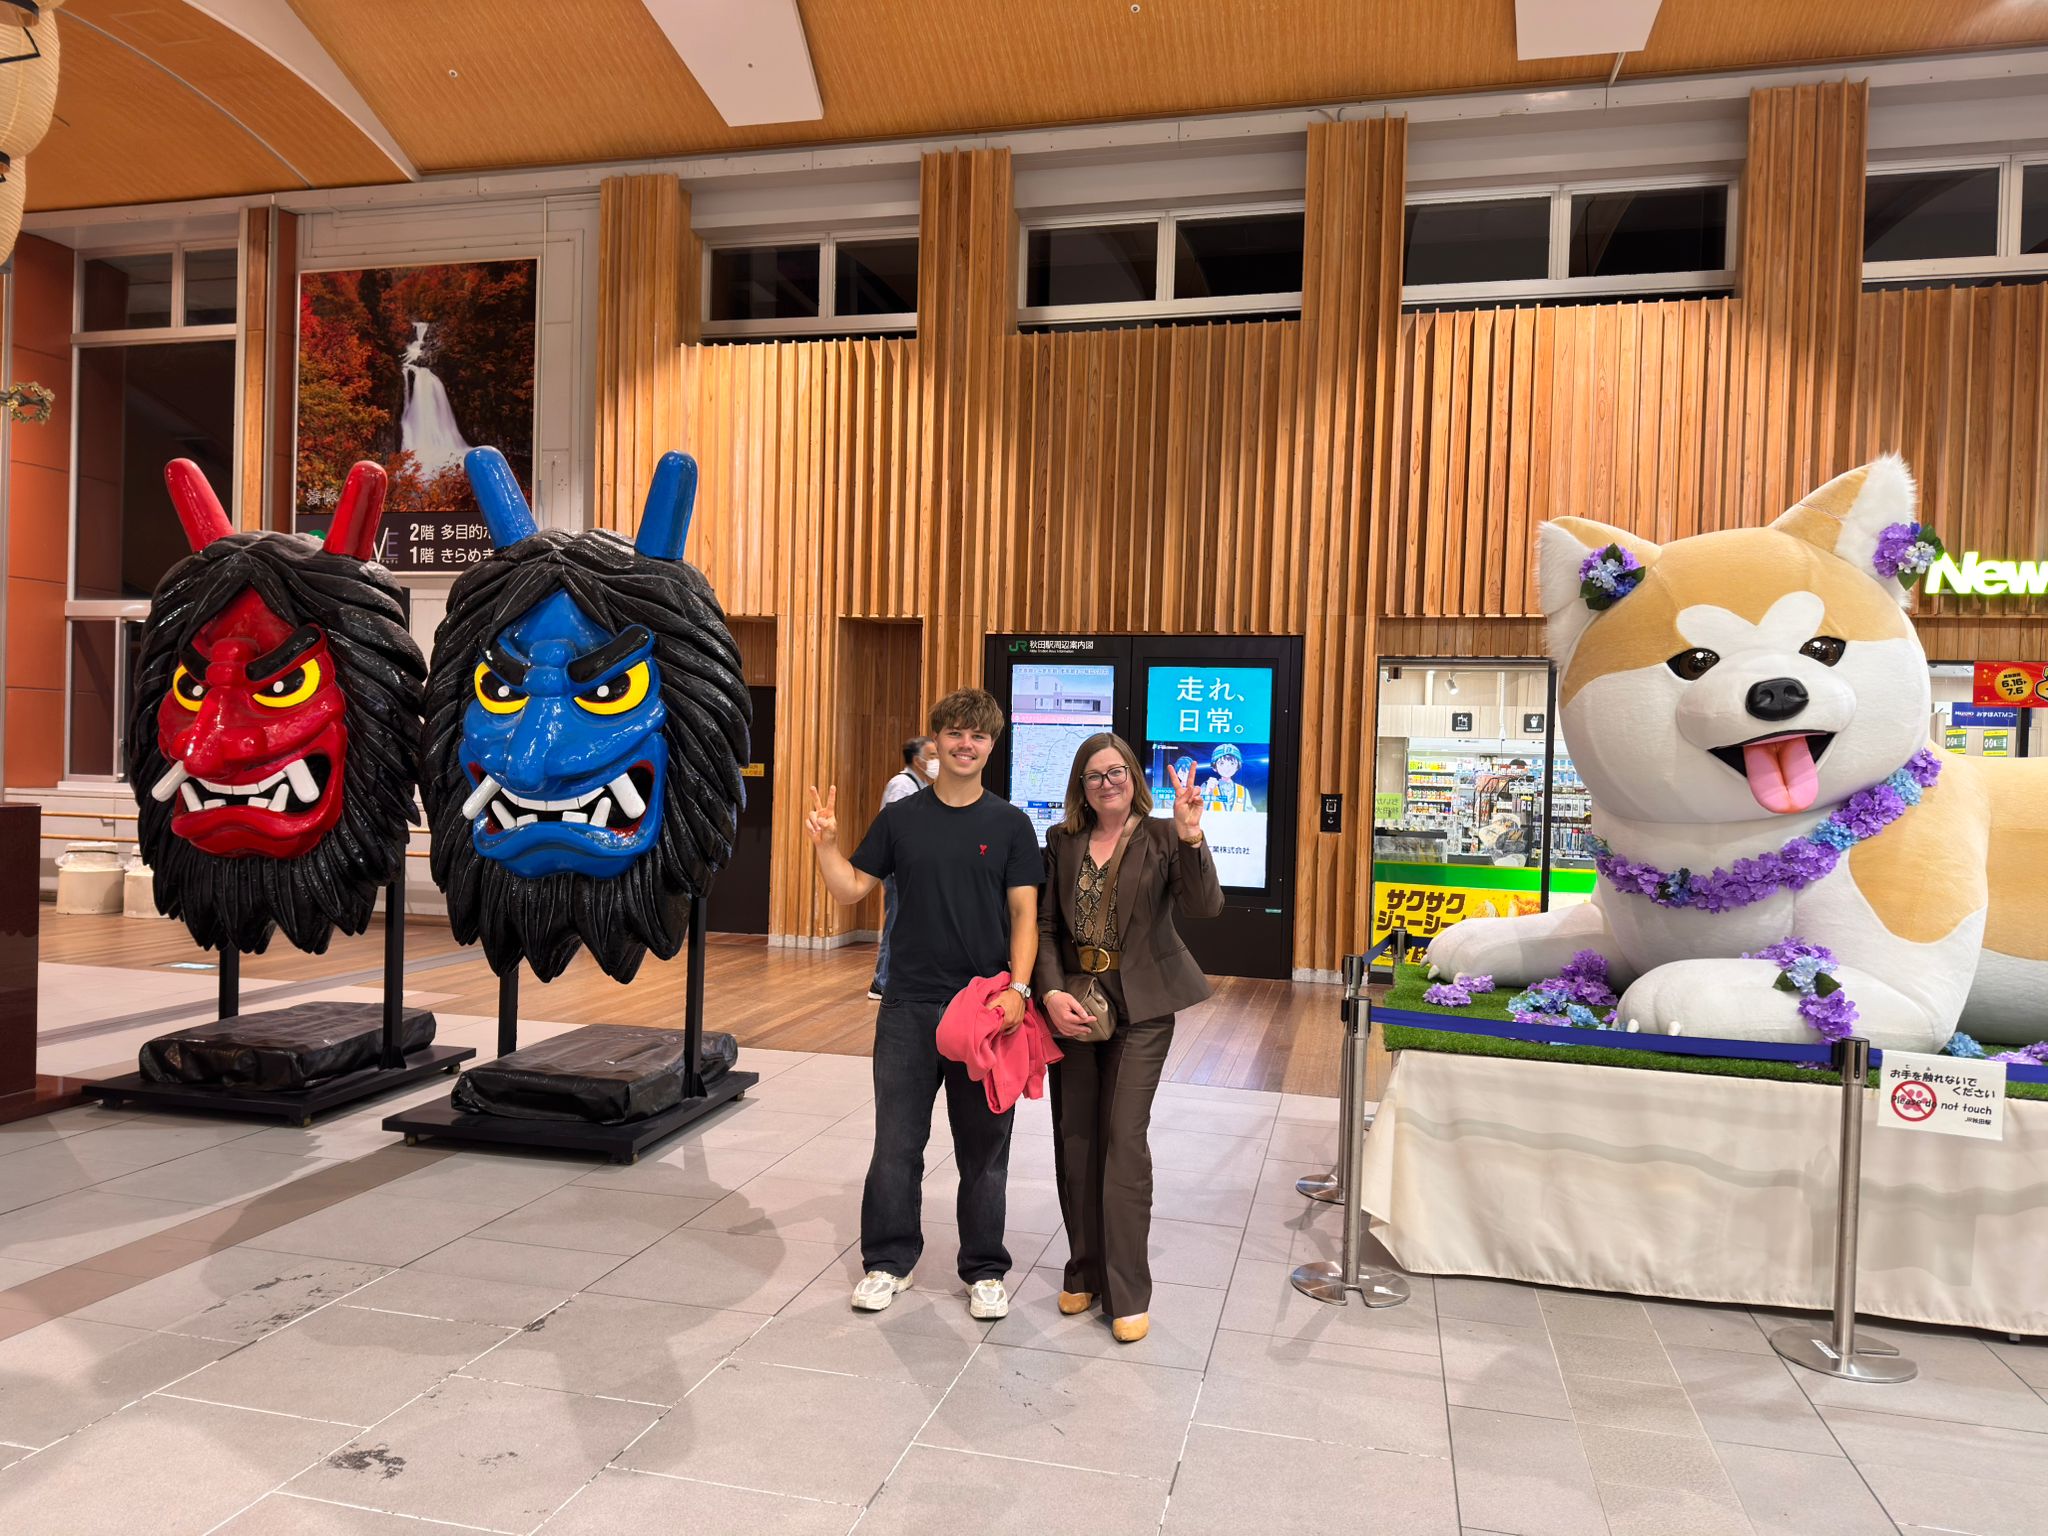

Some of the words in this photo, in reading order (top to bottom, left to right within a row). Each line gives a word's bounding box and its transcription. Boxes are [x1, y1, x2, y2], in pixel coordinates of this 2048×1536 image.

[409, 523, 435, 541] 2階
[409, 545, 435, 564] 1階
[1008, 640, 1028, 653] JR
[1176, 675, 1245, 702] 走れ、
[1179, 707, 1244, 734] 日常。
[1386, 889, 1466, 914] サクサク
[1375, 910, 1466, 935] ジューシー
[1890, 1069, 1978, 1087] お手を触れないで
[1952, 1086, 1996, 1099] ください
[1925, 1099, 1938, 1109] do
[1940, 1101, 1959, 1111] not
[1962, 1103, 1993, 1115] touch
